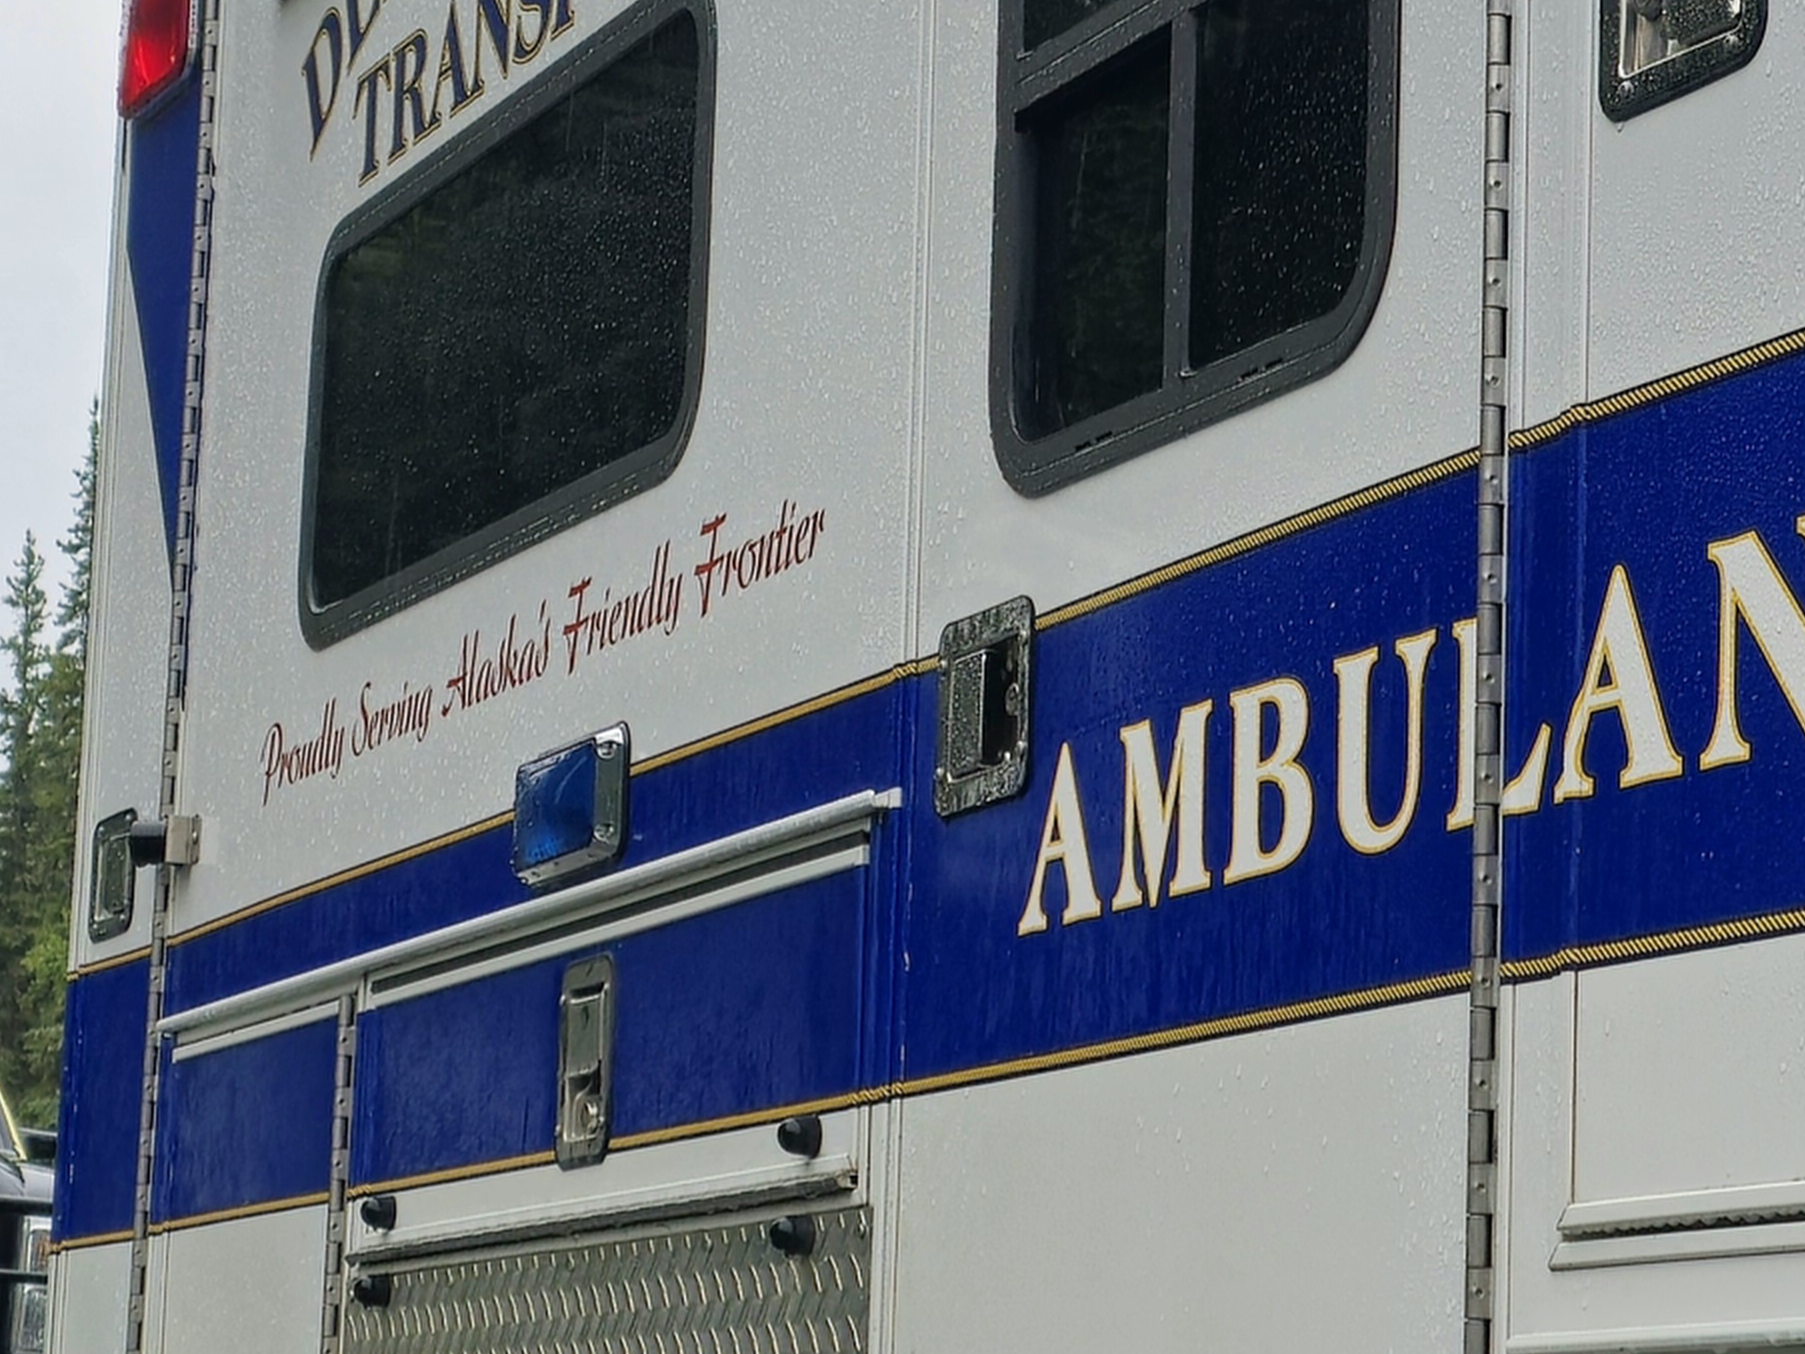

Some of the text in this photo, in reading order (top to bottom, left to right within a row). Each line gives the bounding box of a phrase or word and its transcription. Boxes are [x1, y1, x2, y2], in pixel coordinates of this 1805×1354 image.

[260, 498, 826, 806] Proudly Serving Alaska's Friendly Frontier
